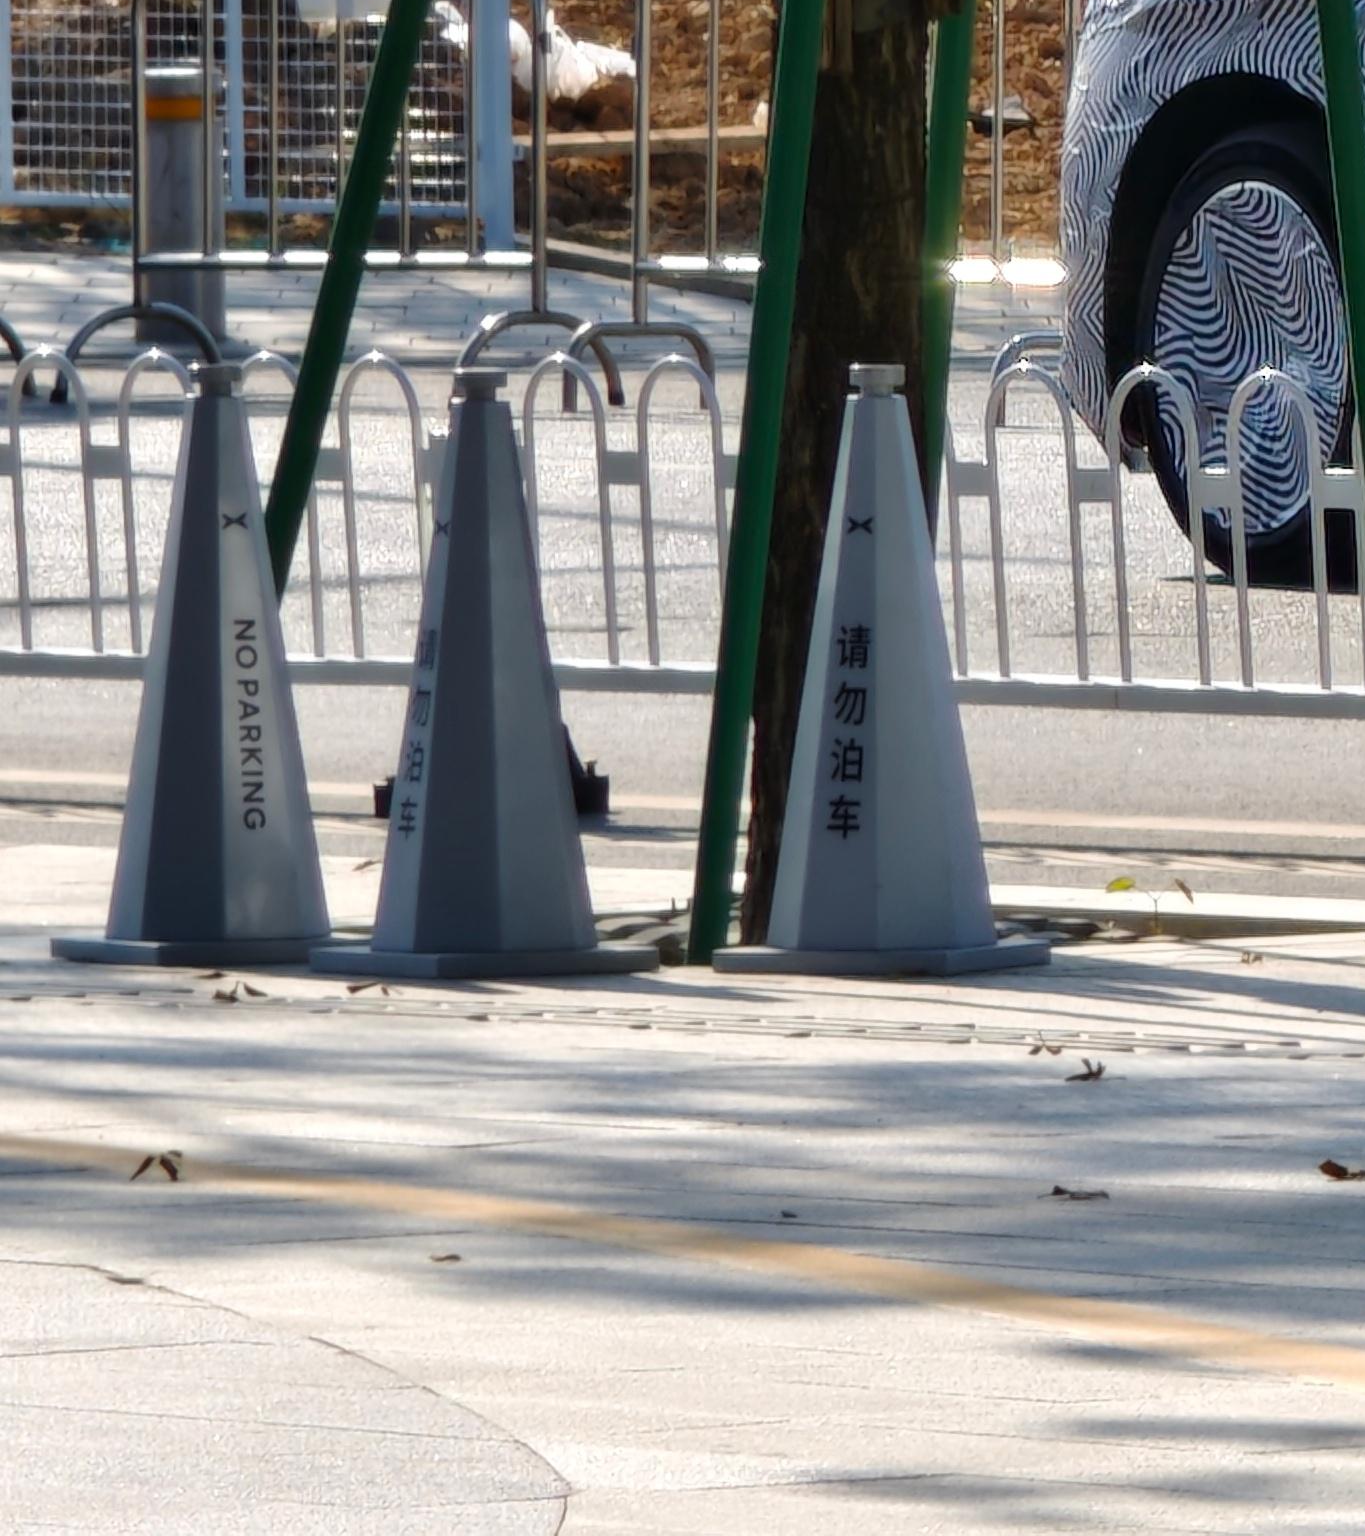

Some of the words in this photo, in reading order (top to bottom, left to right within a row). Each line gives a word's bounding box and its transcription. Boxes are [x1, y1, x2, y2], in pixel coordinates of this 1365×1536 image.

[234, 618, 258, 669] NO
[237, 678, 266, 831] PARKING
[826, 625, 871, 840] 请勿泊车
